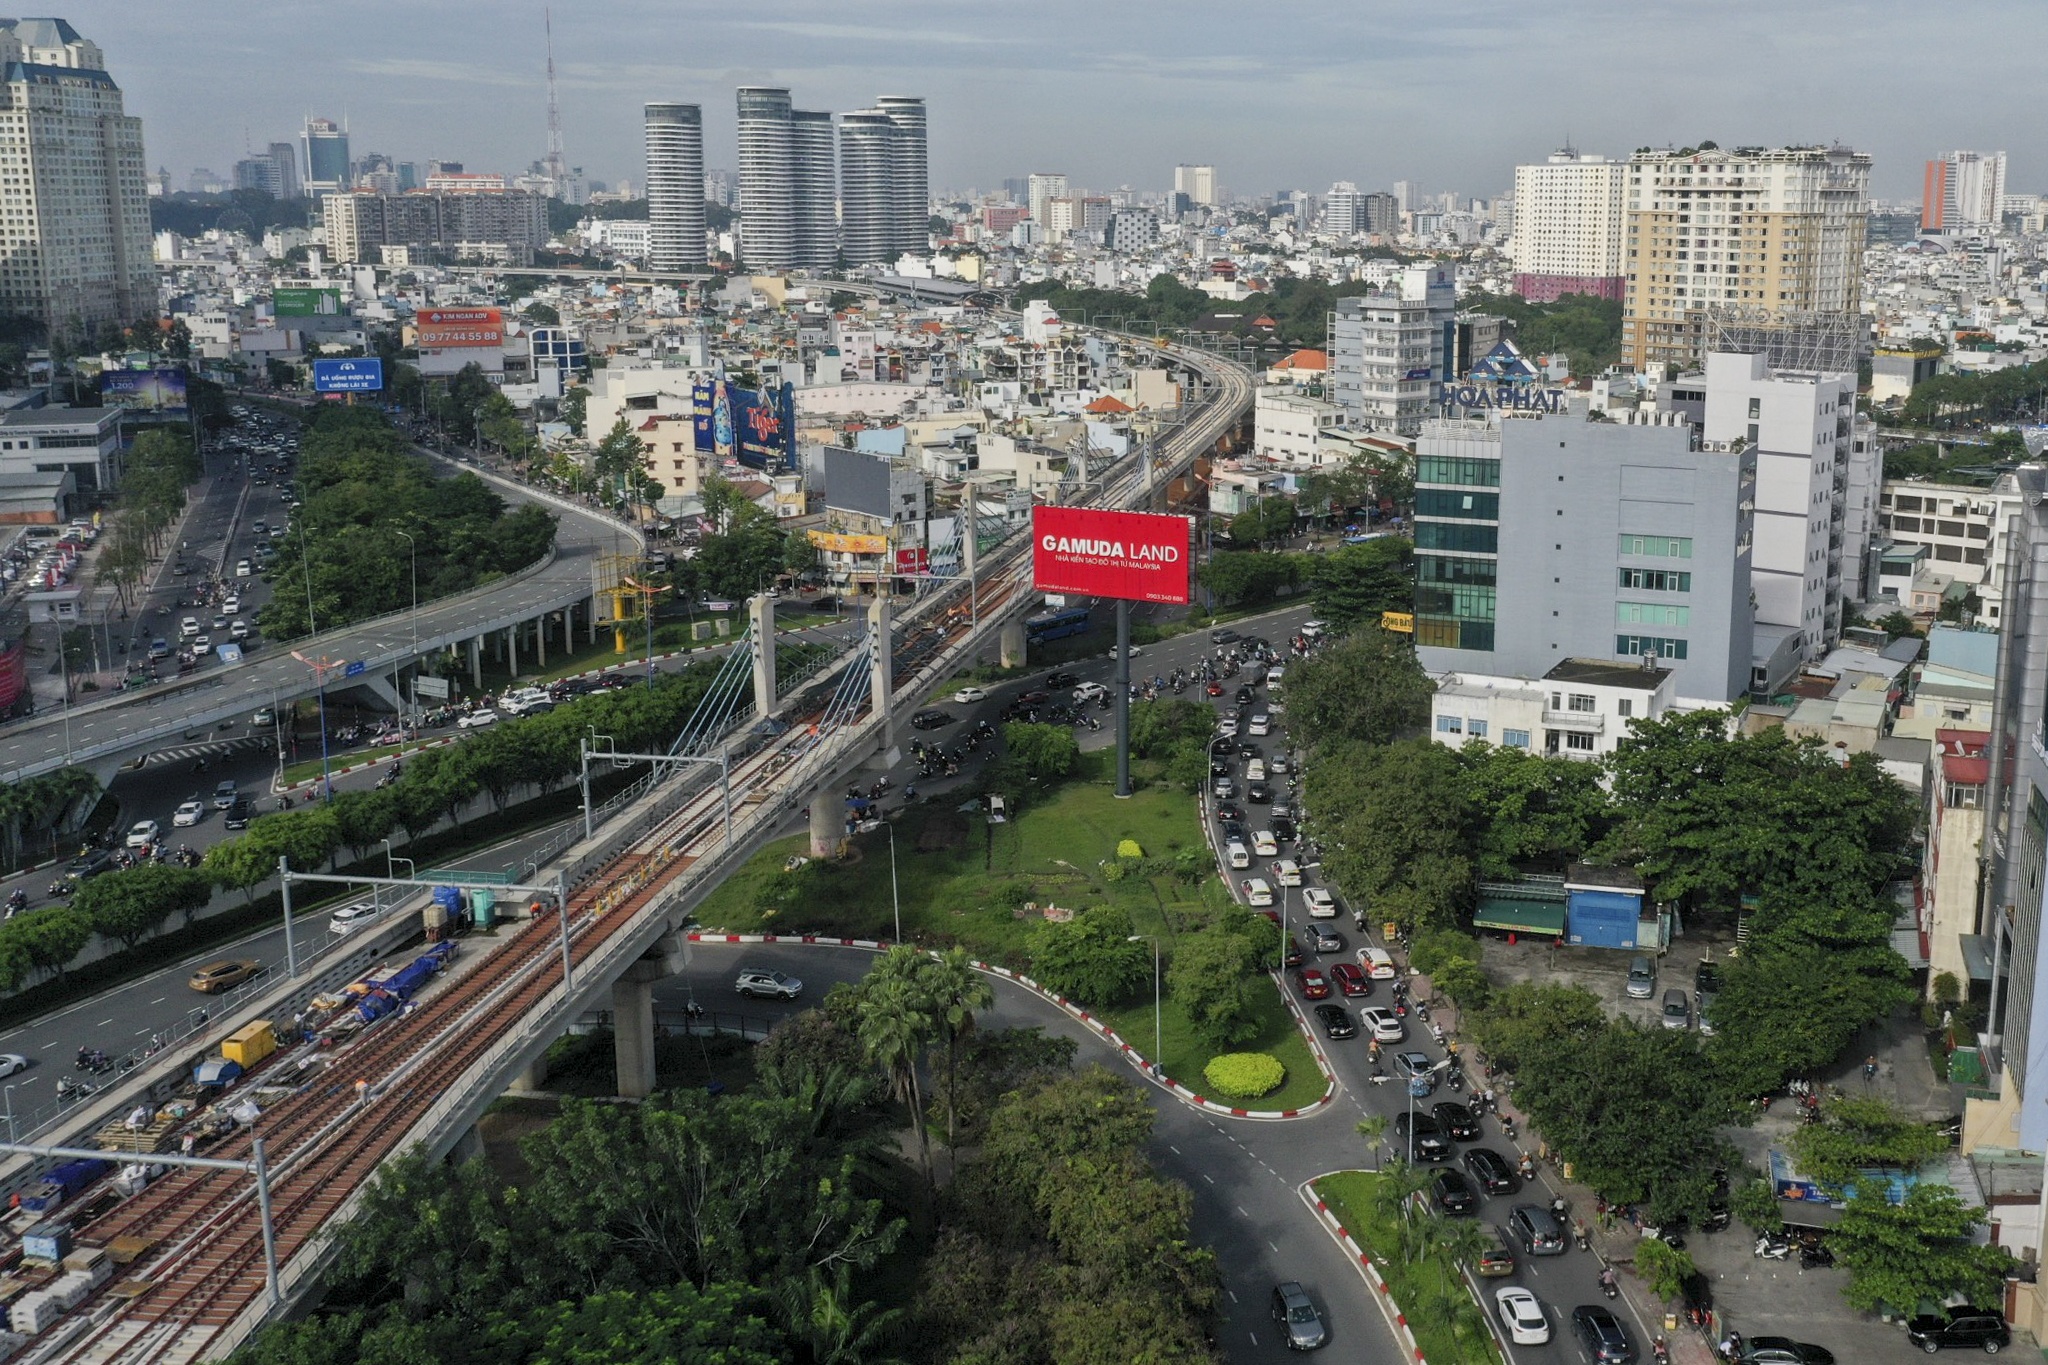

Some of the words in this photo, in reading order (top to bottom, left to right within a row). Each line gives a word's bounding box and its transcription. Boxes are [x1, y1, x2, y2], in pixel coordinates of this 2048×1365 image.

[422, 333, 436, 341] 09
[438, 333, 451, 341] 77
[452, 332, 466, 340] 44
[468, 332, 481, 340] 55
[484, 332, 497, 340] 88
[746, 406, 779, 442] Tiger
[1042, 534, 1124, 558] GAMUDA
[1130, 542, 1178, 562] LAND
[1055, 554, 1069, 563] NHÀ
[1129, 562, 1161, 571] MALAYSIA
